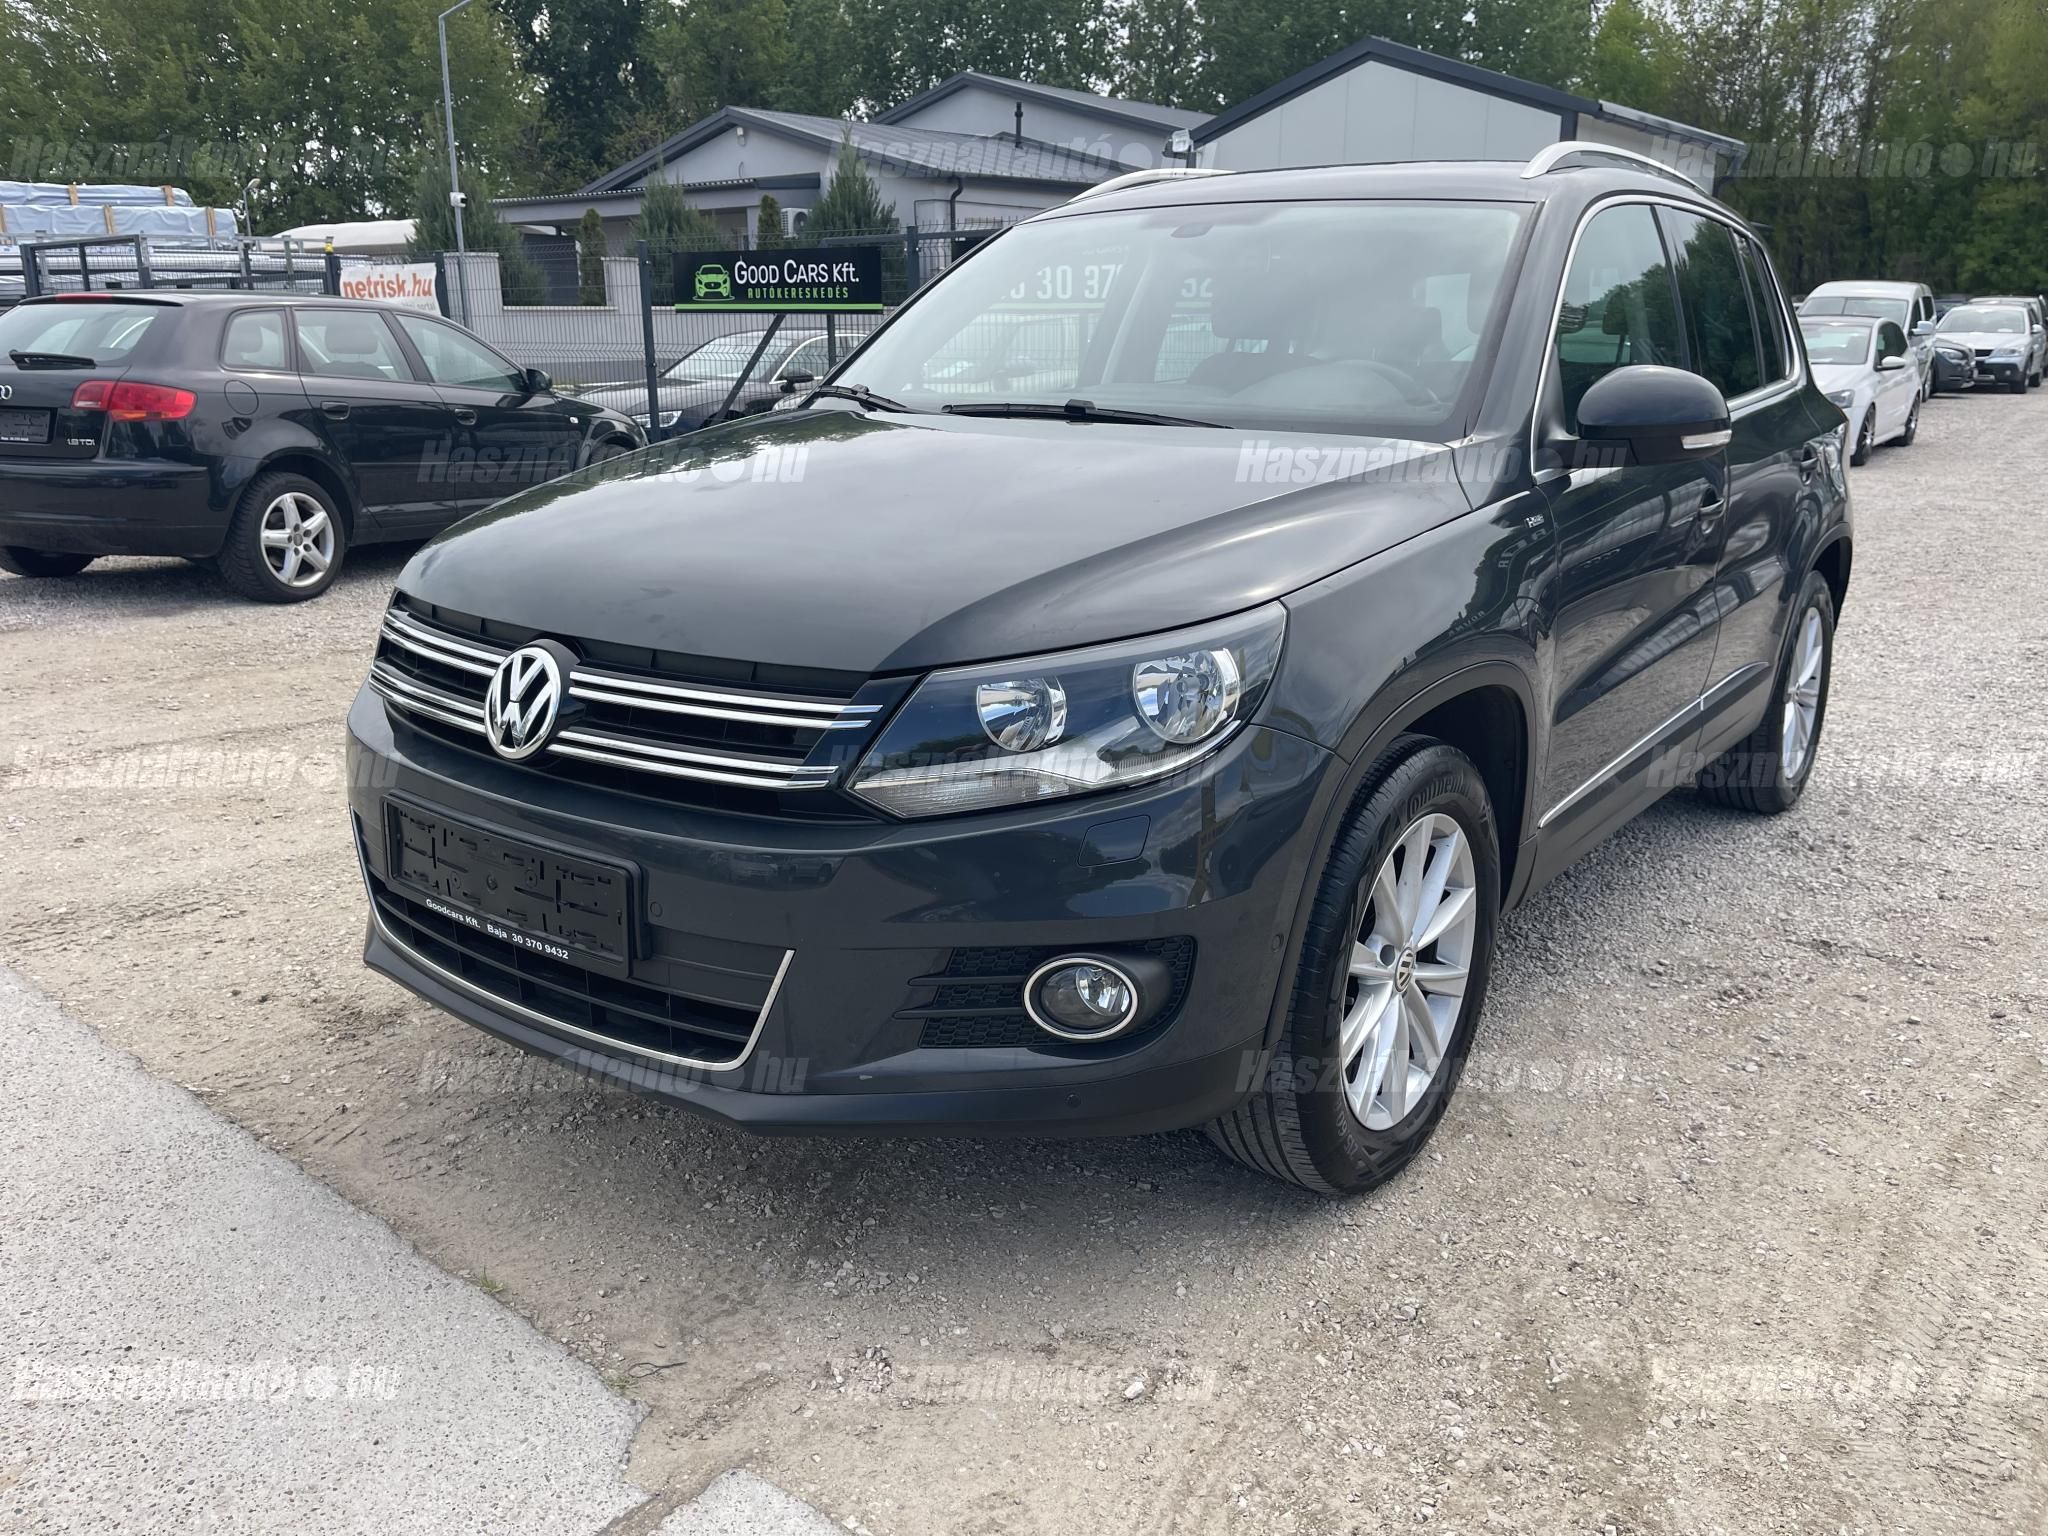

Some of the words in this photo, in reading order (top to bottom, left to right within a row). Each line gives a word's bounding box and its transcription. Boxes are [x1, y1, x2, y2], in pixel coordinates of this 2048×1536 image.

[734, 259, 779, 284] GOOD
[784, 259, 829, 283] CARS
[832, 262, 859, 282] Kft.
[343, 273, 433, 298] netrisk.hu
[747, 285, 849, 299] AUTÓKERESKEDÉS
[79, 438, 96, 446] TDI
[426, 899, 464, 922] Goodcars
[465, 915, 481, 929] Kft.
[487, 923, 508, 939] Baja
[511, 933, 524, 944] 30
[525, 937, 543, 951] 370
[544, 944, 569, 960] 9432
